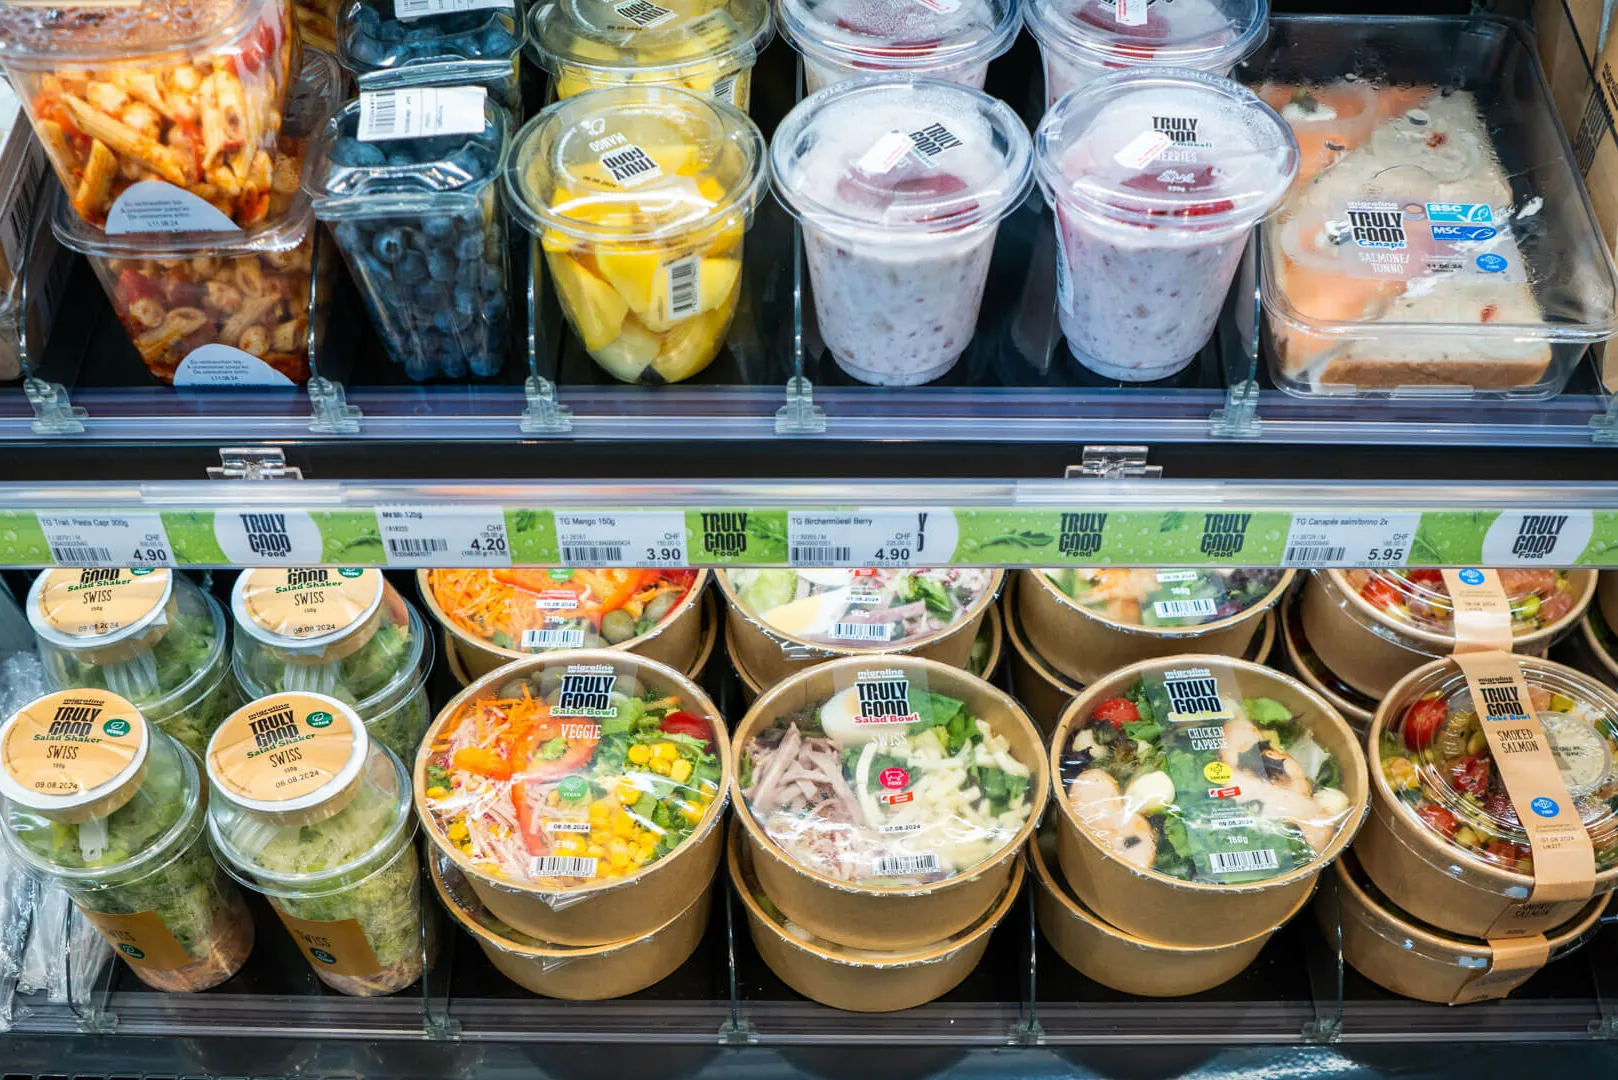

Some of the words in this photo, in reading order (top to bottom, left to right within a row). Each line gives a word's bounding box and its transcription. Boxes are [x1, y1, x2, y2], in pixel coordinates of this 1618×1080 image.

[631, 5, 671, 27] TRULY
[1152, 116, 1198, 131] TRULY
[589, 132, 628, 153] MANGO
[923, 122, 963, 150] TRULY
[909, 131, 943, 157] GOOD
[602, 147, 646, 169] GOOD
[612, 157, 658, 181] TRULY
[1430, 203, 1462, 212] asc
[1348, 211, 1401, 227] TRULY
[1354, 228, 1405, 242] GOOD
[1433, 226, 1462, 235] MSC
[1358, 240, 1407, 249] Canapé
[239, 513, 287, 533] TRULY
[572, 518, 596, 527] Mango
[598, 517, 616, 526] 150g
[701, 512, 748, 533] TRULY
[792, 517, 803, 526] TG
[853, 517, 873, 527] Berry
[1060, 512, 1108, 533] TRULY
[1203, 513, 1251, 533] TRULY
[1379, 518, 1389, 526] 2x
[1518, 515, 1569, 535] TRULY
[248, 533, 292, 553] GOOD
[664, 532, 680, 540] CHF
[704, 533, 747, 552] GOOD
[895, 532, 912, 540] CHF
[1058, 533, 1102, 552] GOOD
[1200, 533, 1246, 553] GOOD
[1393, 533, 1409, 541] CHF
[470, 539, 506, 551] 4.20
[1512, 535, 1557, 555] GOOD
[133, 549, 167, 561] 4.90
[646, 548, 681, 560] 3.90
[874, 548, 910, 560] 4.90
[1207, 550, 1233, 558] Food
[1367, 548, 1404, 560] 5.95
[1517, 551, 1544, 559] Food
[81, 569, 120, 584] GOOD
[288, 569, 329, 586] GOOD
[67, 582, 94, 592] Salad
[96, 579, 132, 588] Shaker
[275, 583, 303, 594] Salad
[305, 581, 343, 590] Shaker
[82, 589, 112, 605] SWISS
[294, 591, 325, 606] SWISS
[567, 664, 614, 674] migrolino
[857, 669, 905, 679] migrolino
[562, 676, 615, 694] TRULY
[856, 682, 908, 700] TRULY
[1165, 680, 1217, 698] TRULY
[560, 693, 609, 709] GOOD
[1480, 687, 1519, 703] TRULY
[586, 708, 617, 716] Bowl
[861, 701, 909, 717] GOOD
[1173, 698, 1222, 714] GOOD
[1486, 702, 1524, 717] GOOD
[53, 706, 104, 722] TRULY
[853, 715, 888, 724] Salad
[889, 713, 919, 722] Bowl
[47, 721, 93, 737] GOOD
[249, 710, 295, 735] TRULY
[33, 733, 62, 742] Salad
[64, 735, 102, 743] Shaker
[255, 724, 300, 748] GOOD
[560, 723, 602, 740] VEGGIE
[1187, 727, 1226, 739] CHICKEN
[1497, 729, 1534, 742] SMOKED
[46, 745, 79, 760] SWISS
[246, 744, 277, 759] Salad
[277, 733, 317, 747] Shaker
[1501, 740, 1539, 754] SALMON
[269, 747, 303, 768] SWISS
[34, 781, 79, 790] 09.08.2024
